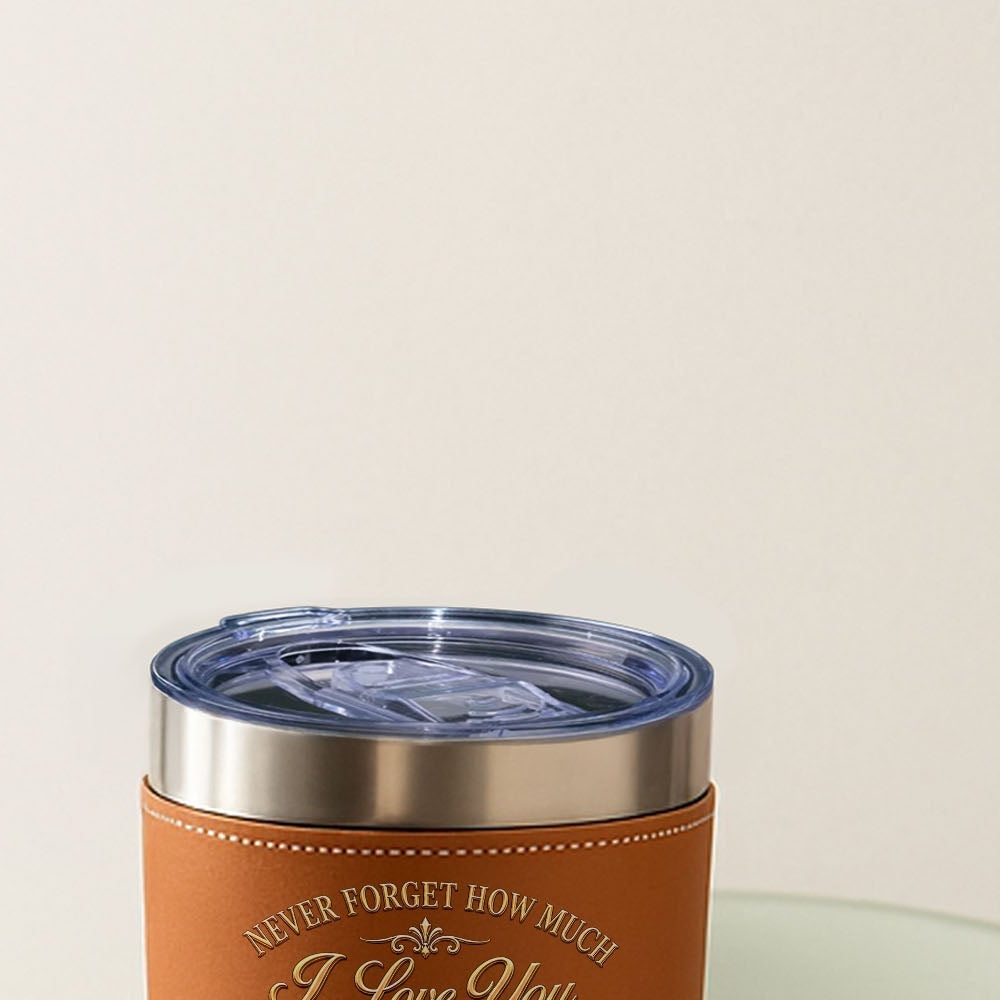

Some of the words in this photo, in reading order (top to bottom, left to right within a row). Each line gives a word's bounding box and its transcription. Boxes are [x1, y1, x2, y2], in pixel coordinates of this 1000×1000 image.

[243, 895, 340, 958] NEVER
[341, 881, 459, 915] FORGET
[466, 884, 537, 923] HOW
[535, 903, 620, 968] MUCH
